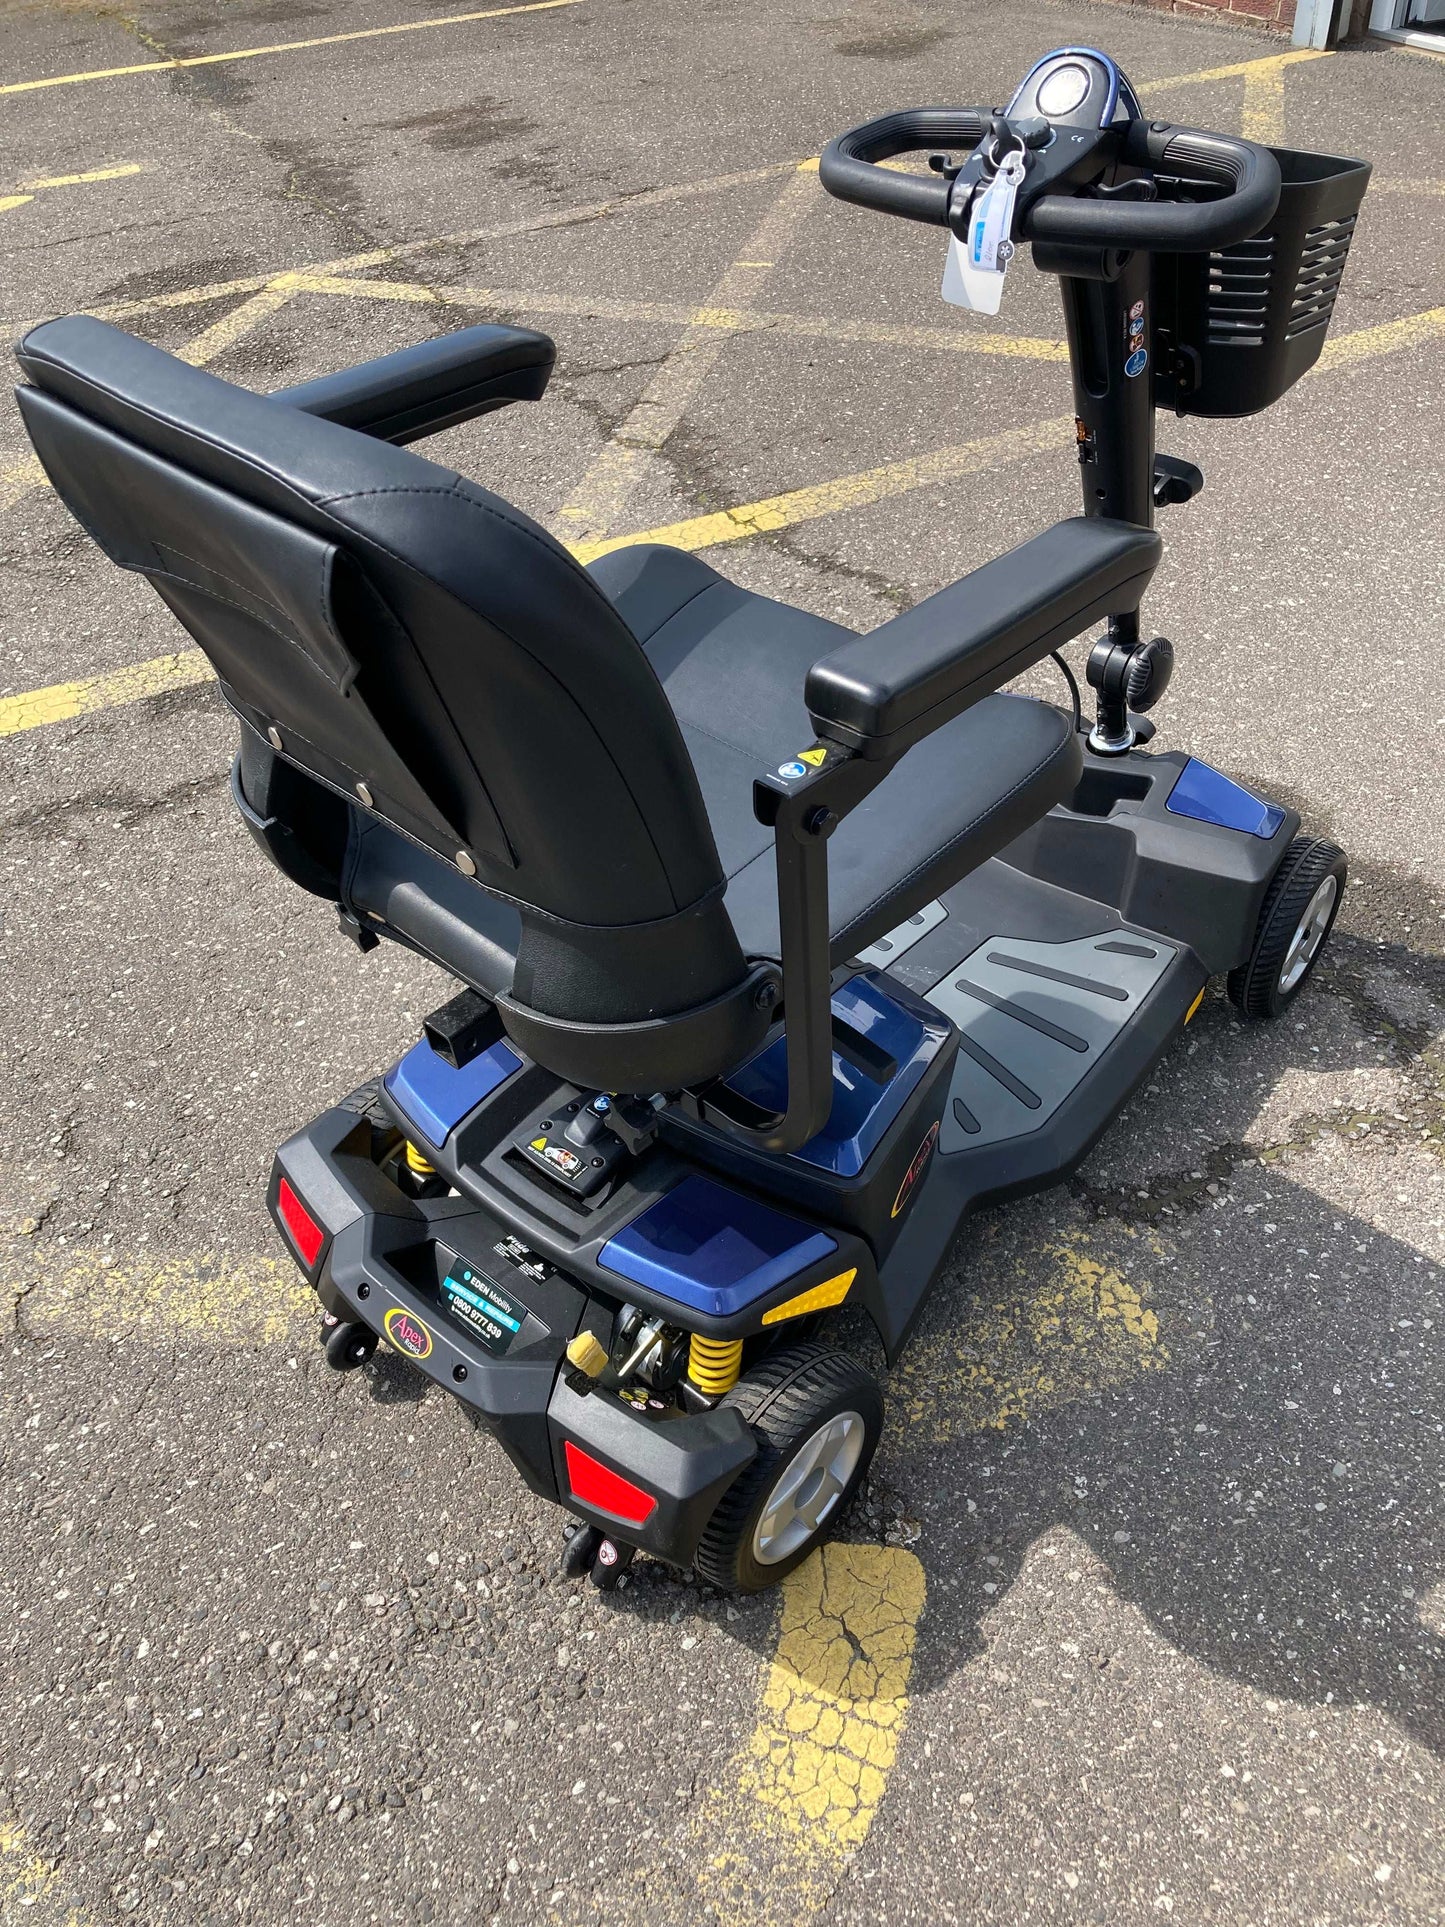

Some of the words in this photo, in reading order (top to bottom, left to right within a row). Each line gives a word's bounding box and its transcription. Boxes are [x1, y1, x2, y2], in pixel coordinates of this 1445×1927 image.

[451, 1282, 479, 1303] SERVICE
[485, 1305, 514, 1327] REPAIRS
[470, 1276, 490, 1296] EDEN
[489, 1290, 512, 1314] Mobility
[391, 1316, 424, 1348] Apex
[453, 1296, 472, 1314] 0800
[470, 1309, 488, 1327] 9777
[486, 1322, 502, 1338] 839
[404, 1338, 420, 1354] Rapid
